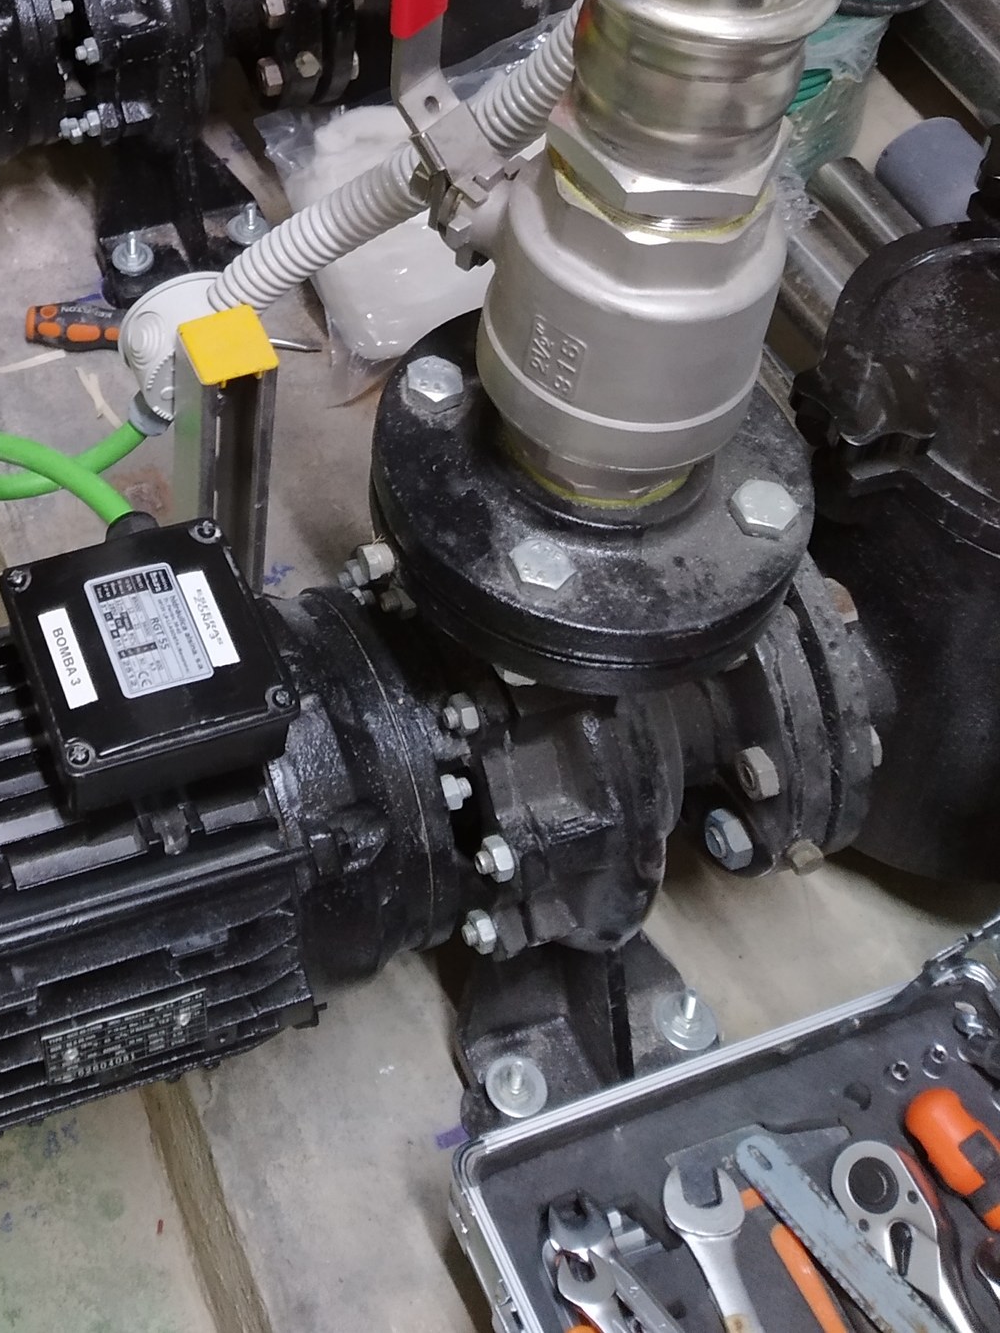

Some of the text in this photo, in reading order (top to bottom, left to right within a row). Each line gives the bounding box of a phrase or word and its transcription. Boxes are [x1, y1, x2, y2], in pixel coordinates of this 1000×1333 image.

[150, 616, 163, 636] RGT
[158, 637, 169, 650] 55
[51, 627, 81, 686] BOMBA 3
